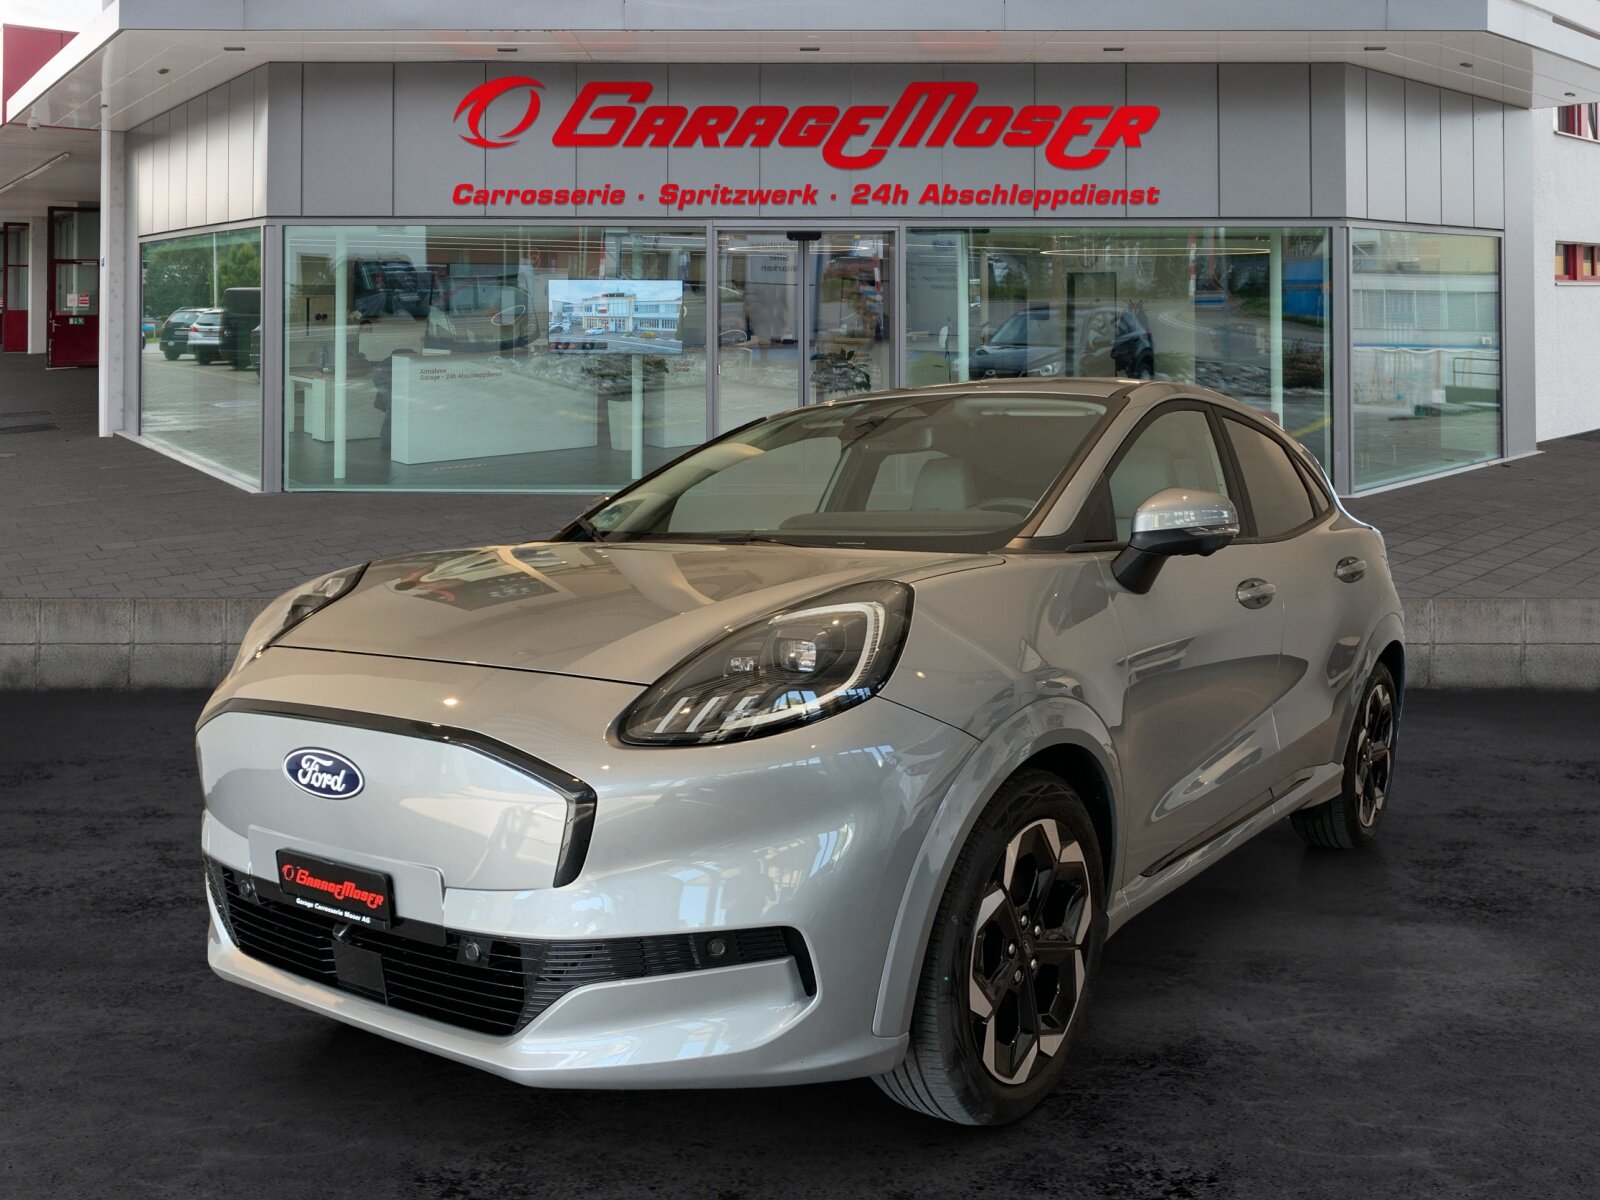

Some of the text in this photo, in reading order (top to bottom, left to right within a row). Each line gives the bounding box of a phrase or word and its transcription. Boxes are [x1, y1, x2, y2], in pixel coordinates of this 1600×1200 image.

[451, 183, 626, 205] Carrosserie
[658, 183, 818, 210] Spritzwerk
[850, 183, 910, 205] 24h
[918, 183, 1160, 210] Abschleppdienst
[419, 367, 447, 375] Annahme
[419, 374, 441, 382] Garage
[298, 755, 346, 792] Ford
[295, 897, 314, 909] Garage
[344, 910, 361, 922] Moser
[361, 915, 371, 924] AG
